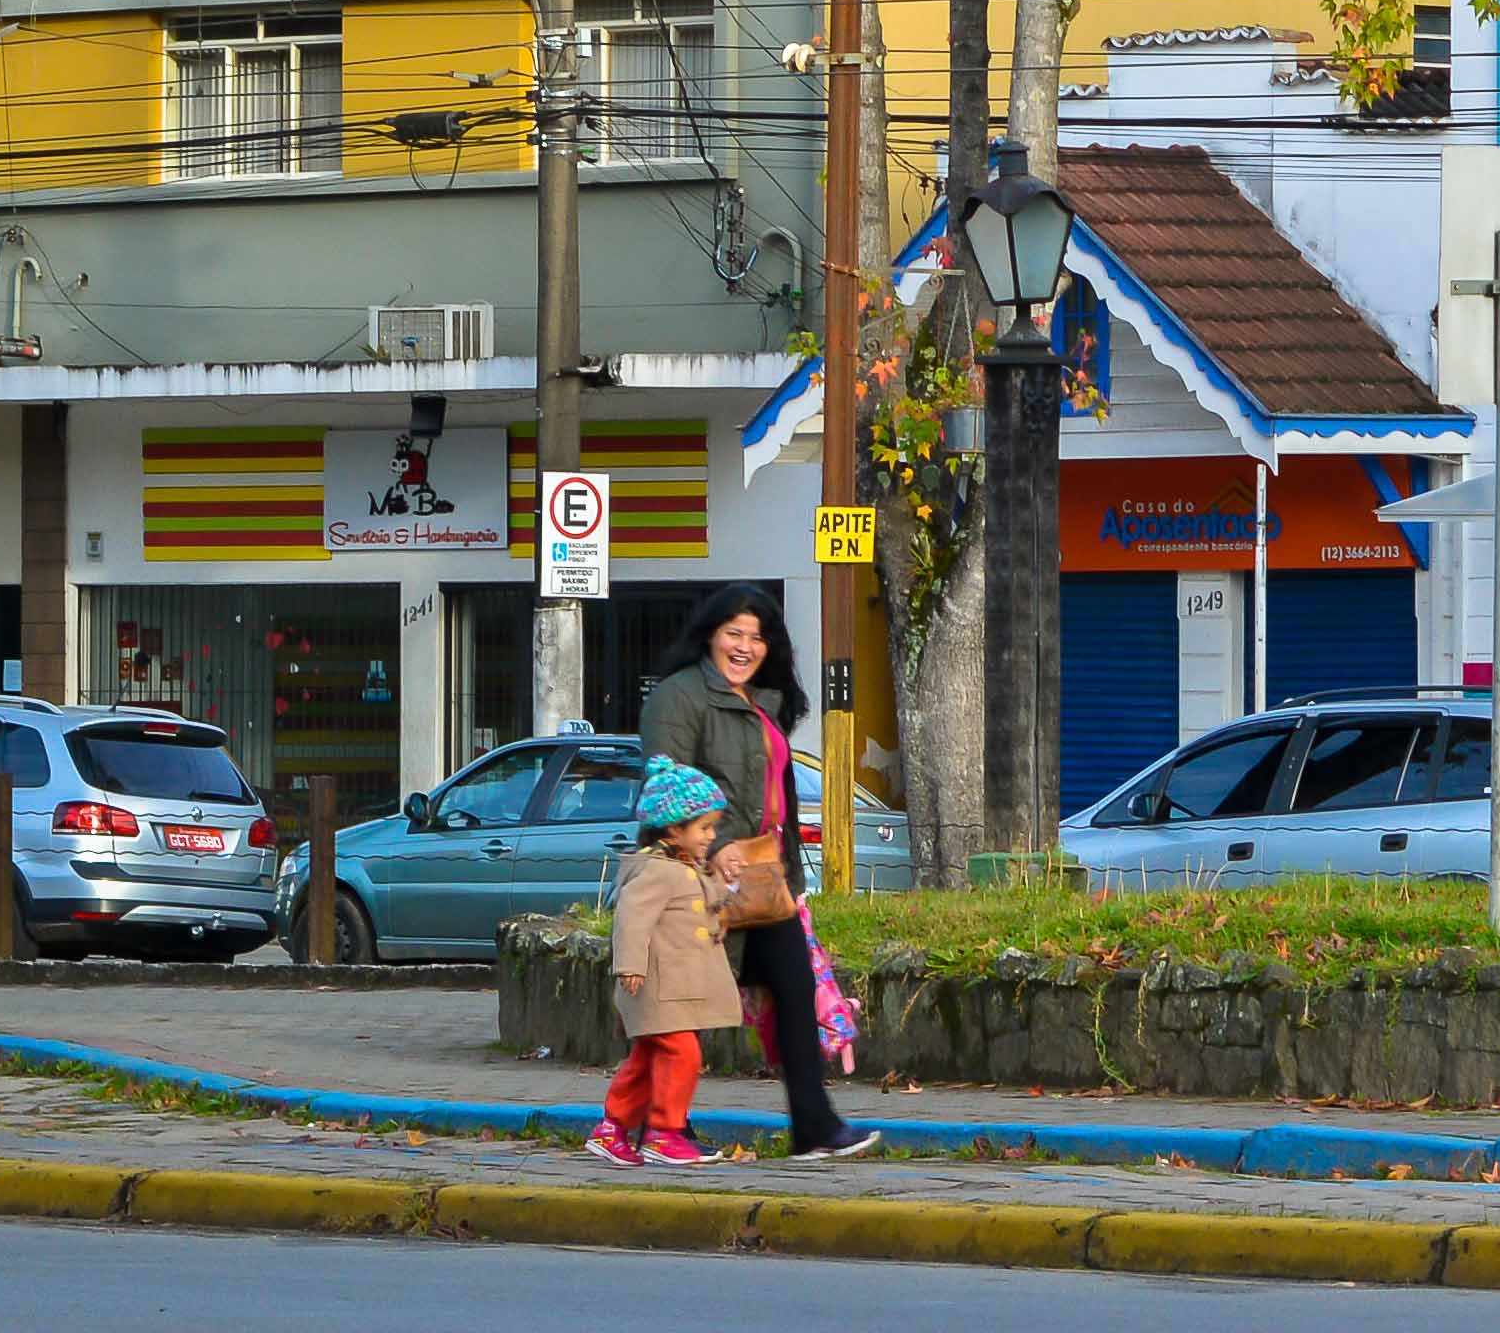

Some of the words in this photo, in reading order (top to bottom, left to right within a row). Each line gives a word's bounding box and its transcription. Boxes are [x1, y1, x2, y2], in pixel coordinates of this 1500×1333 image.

[563, 488, 588, 527] E
[1122, 498, 1167, 514] Casa
[1173, 498, 1194, 513] do
[819, 512, 871, 533] APITE
[1187, 590, 1224, 616] 1249
[569, 721, 591, 733] TAXI
